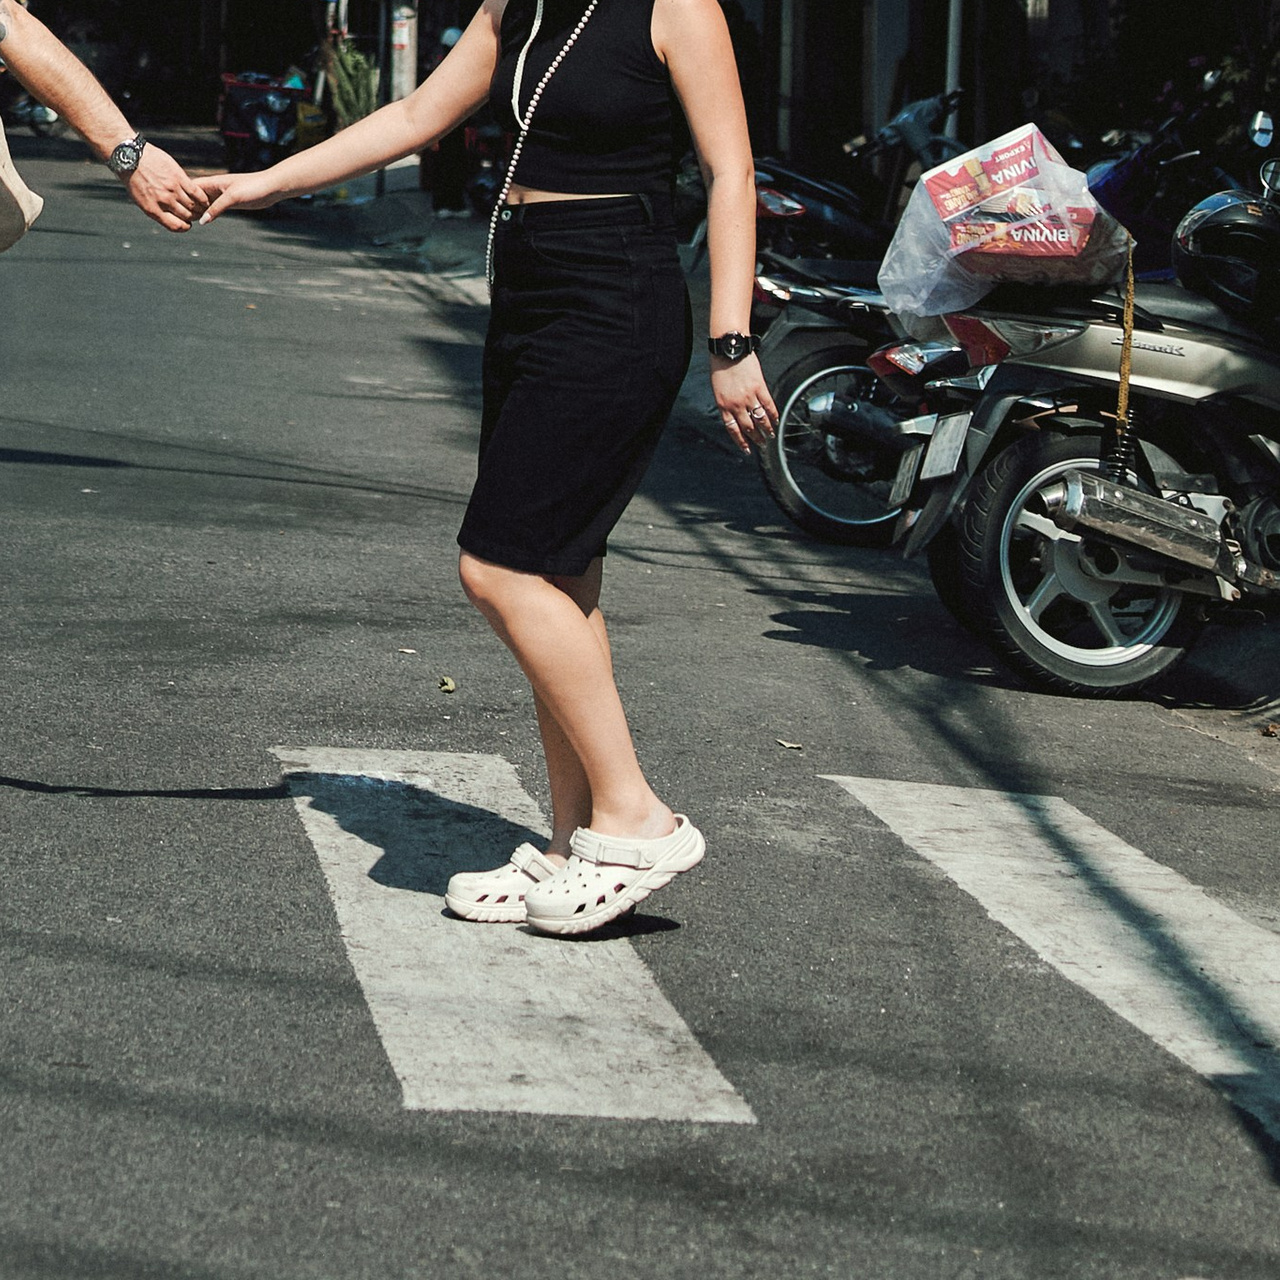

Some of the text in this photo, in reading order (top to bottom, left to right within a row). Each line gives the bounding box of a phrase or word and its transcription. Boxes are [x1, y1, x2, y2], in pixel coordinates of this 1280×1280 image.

[995, 144, 1025, 163] EXPORT
[991, 156, 1037, 185] IVINA
[1010, 228, 1070, 242] BIVINA
